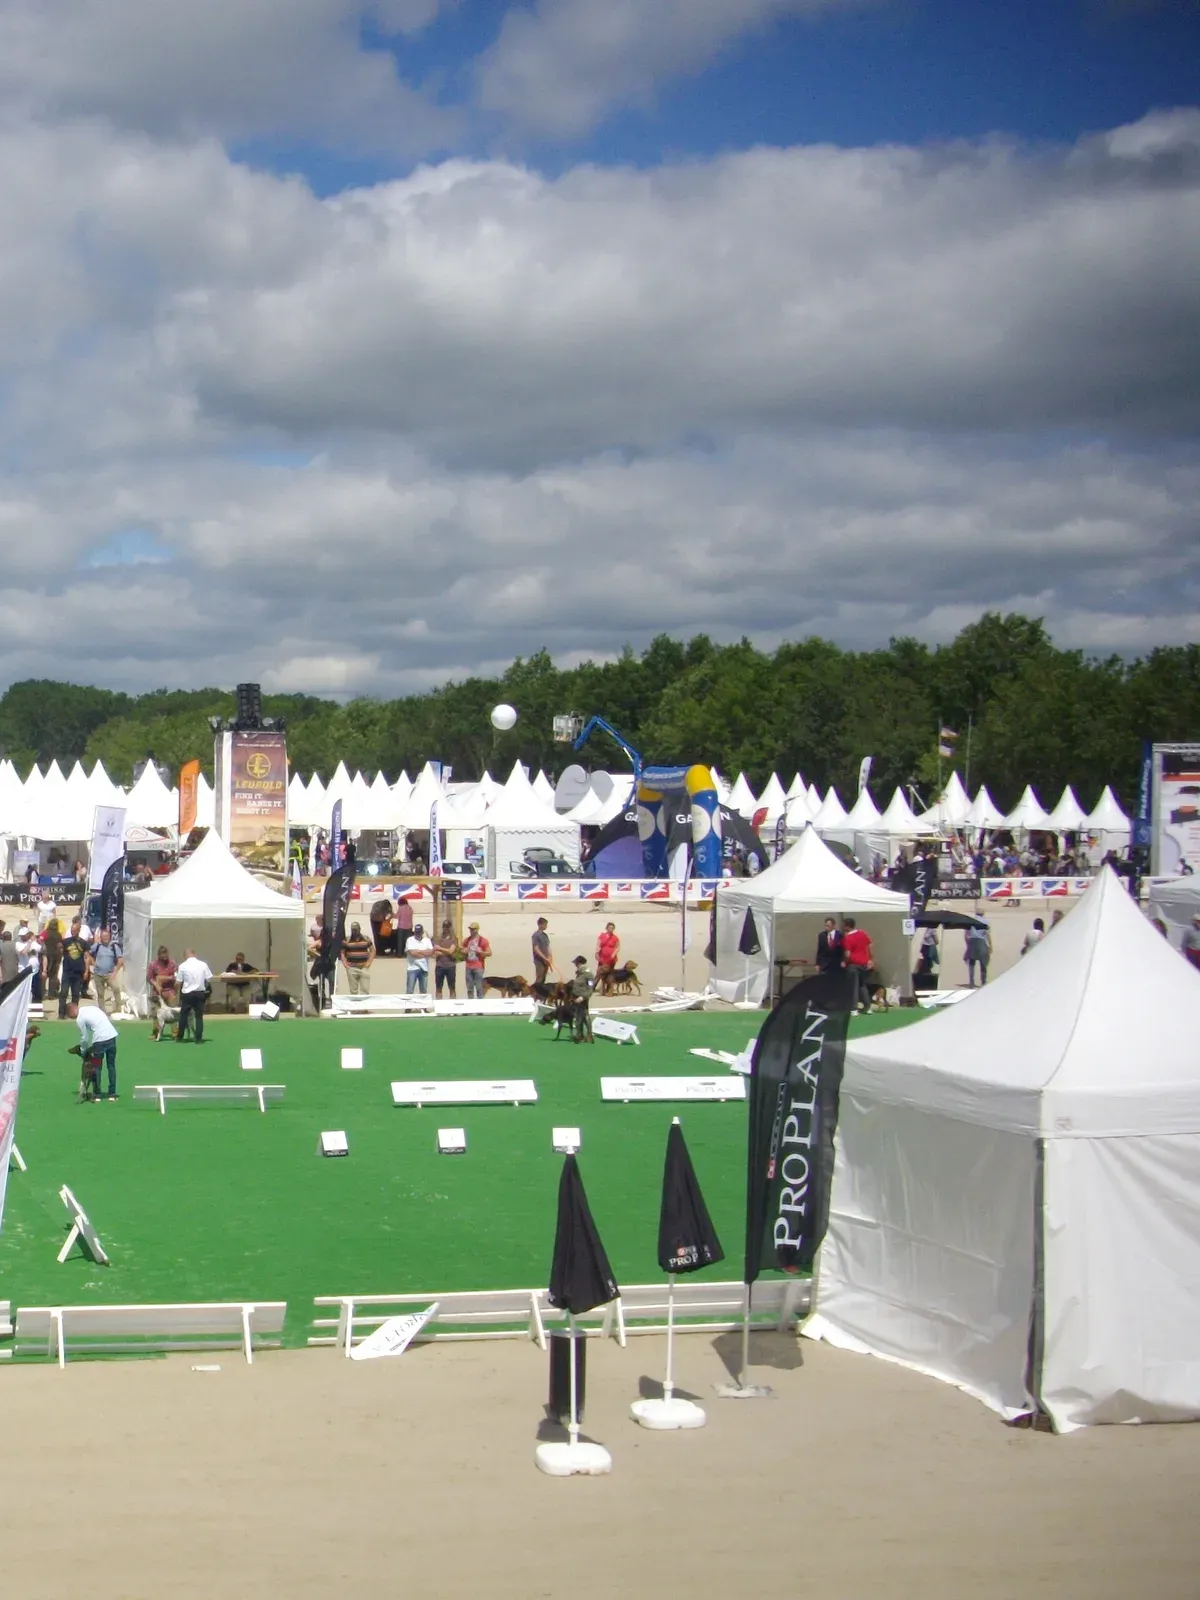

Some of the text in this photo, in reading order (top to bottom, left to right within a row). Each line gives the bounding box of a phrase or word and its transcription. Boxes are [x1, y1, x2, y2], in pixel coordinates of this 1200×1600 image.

[675, 813, 731, 824] GAN
[110, 870, 120, 944] ROPLAN
[668, 1253, 699, 1268] PROP
